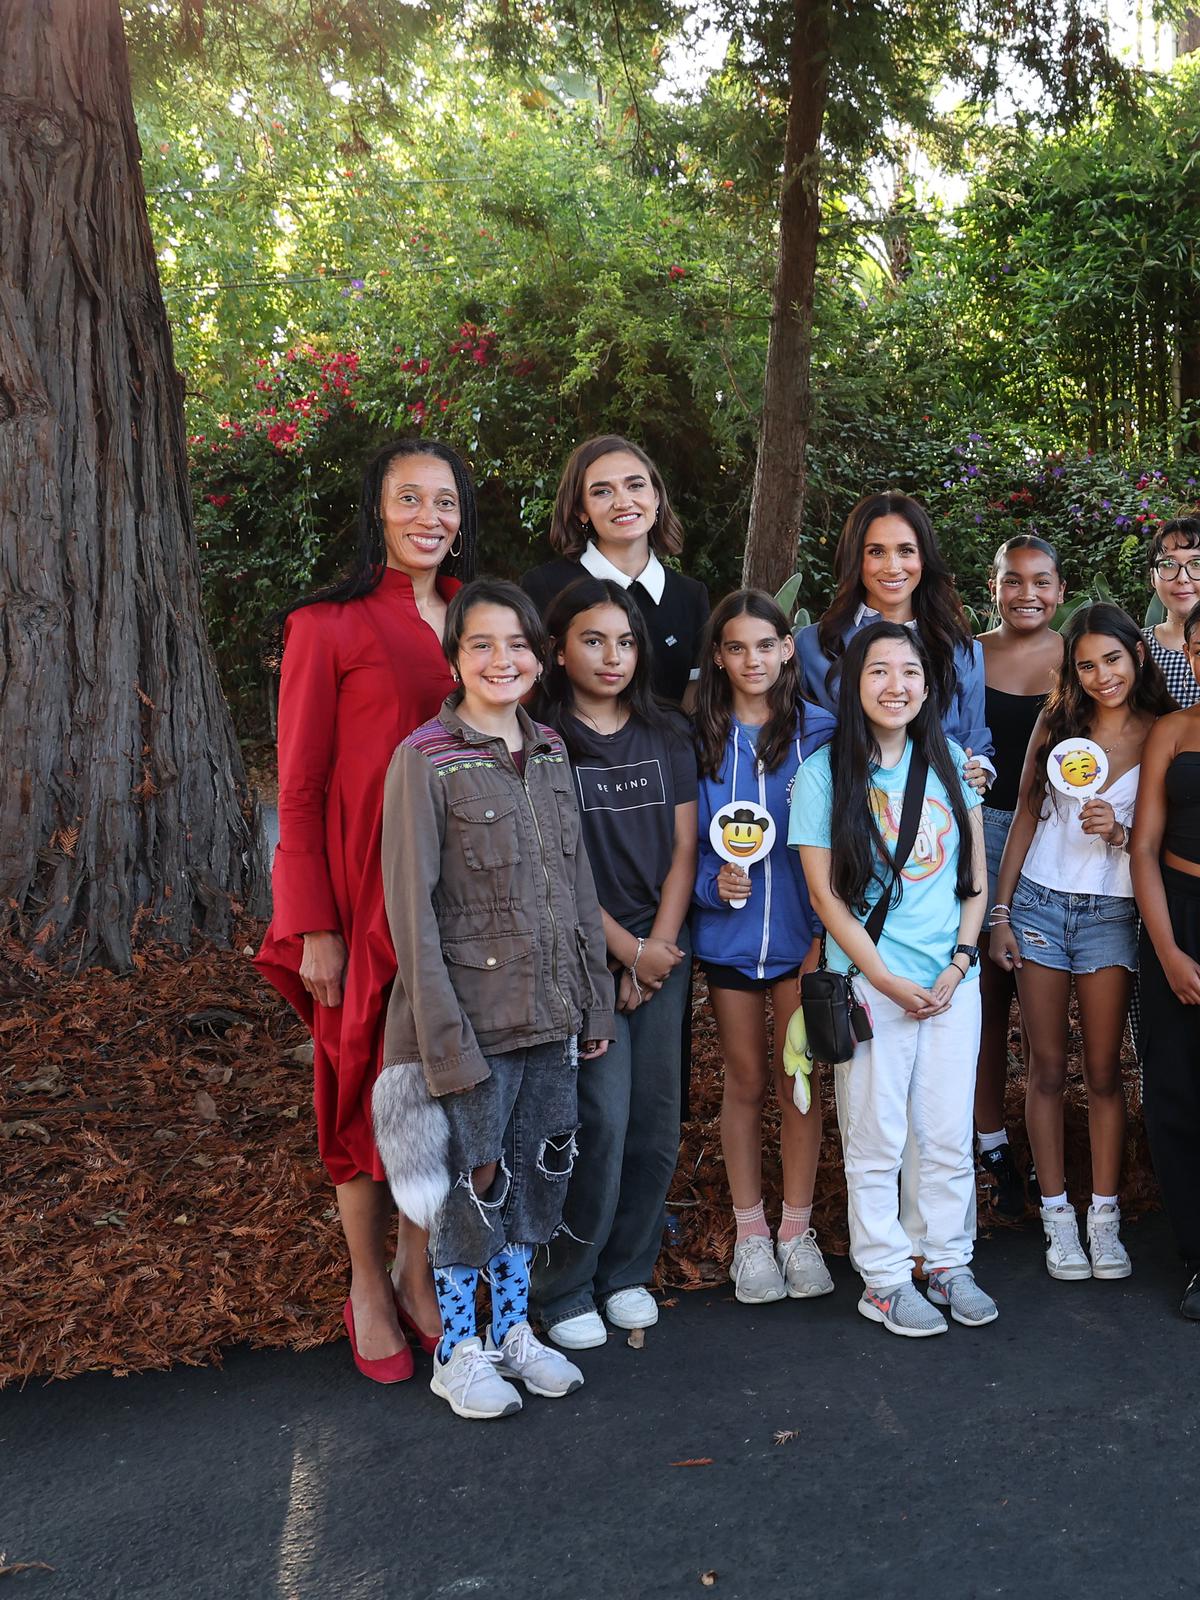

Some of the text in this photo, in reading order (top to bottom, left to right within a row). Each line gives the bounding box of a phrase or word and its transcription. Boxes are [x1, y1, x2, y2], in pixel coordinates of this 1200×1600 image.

[597, 778, 647, 792] BE KIND
[910, 822, 937, 863] OY
